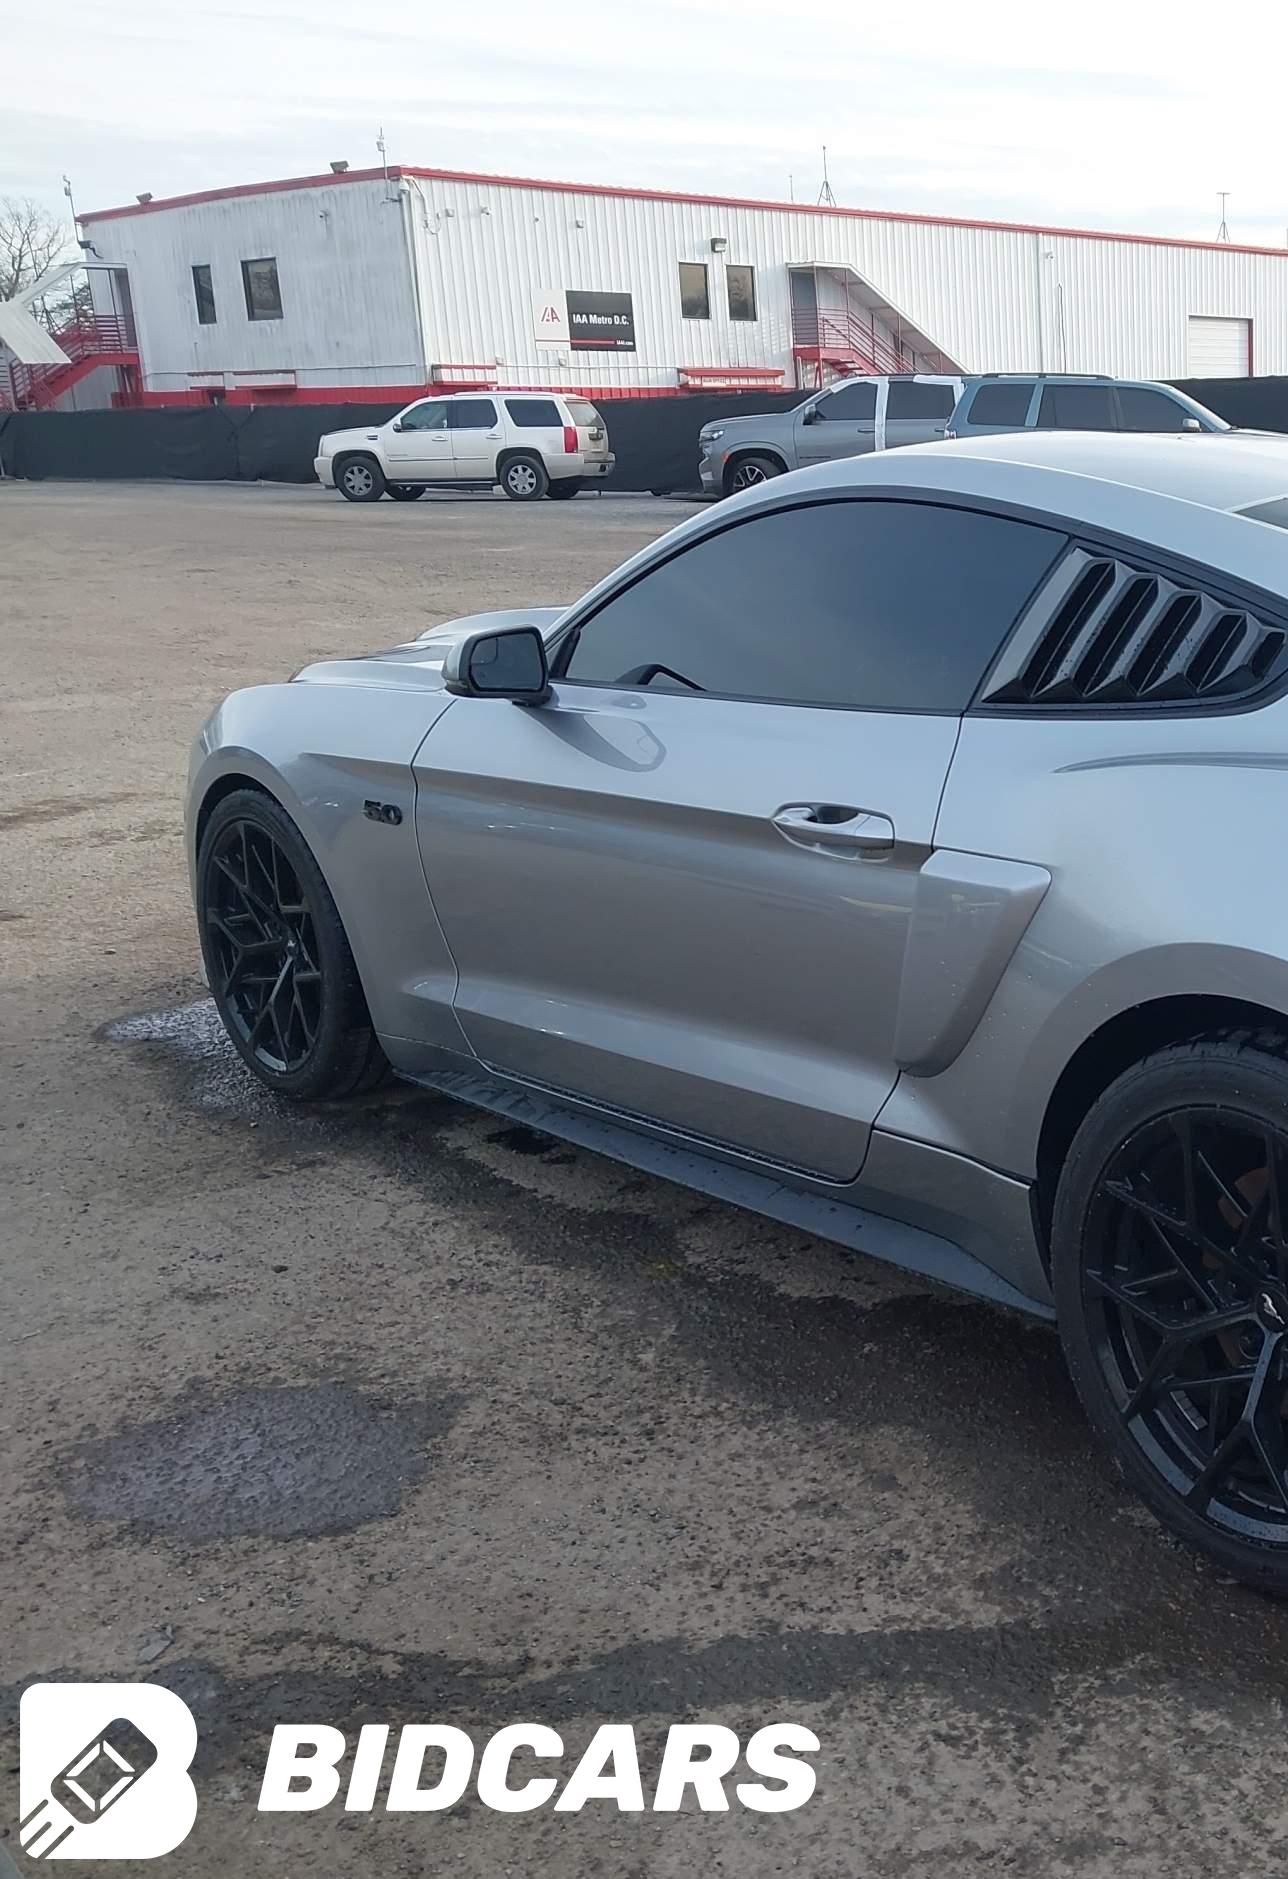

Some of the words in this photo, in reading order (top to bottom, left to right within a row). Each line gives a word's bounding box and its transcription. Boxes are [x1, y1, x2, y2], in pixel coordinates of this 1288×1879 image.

[572, 313, 588, 324] IAA
[589, 314, 613, 325] Metro
[613, 315, 630, 325] D.C.
